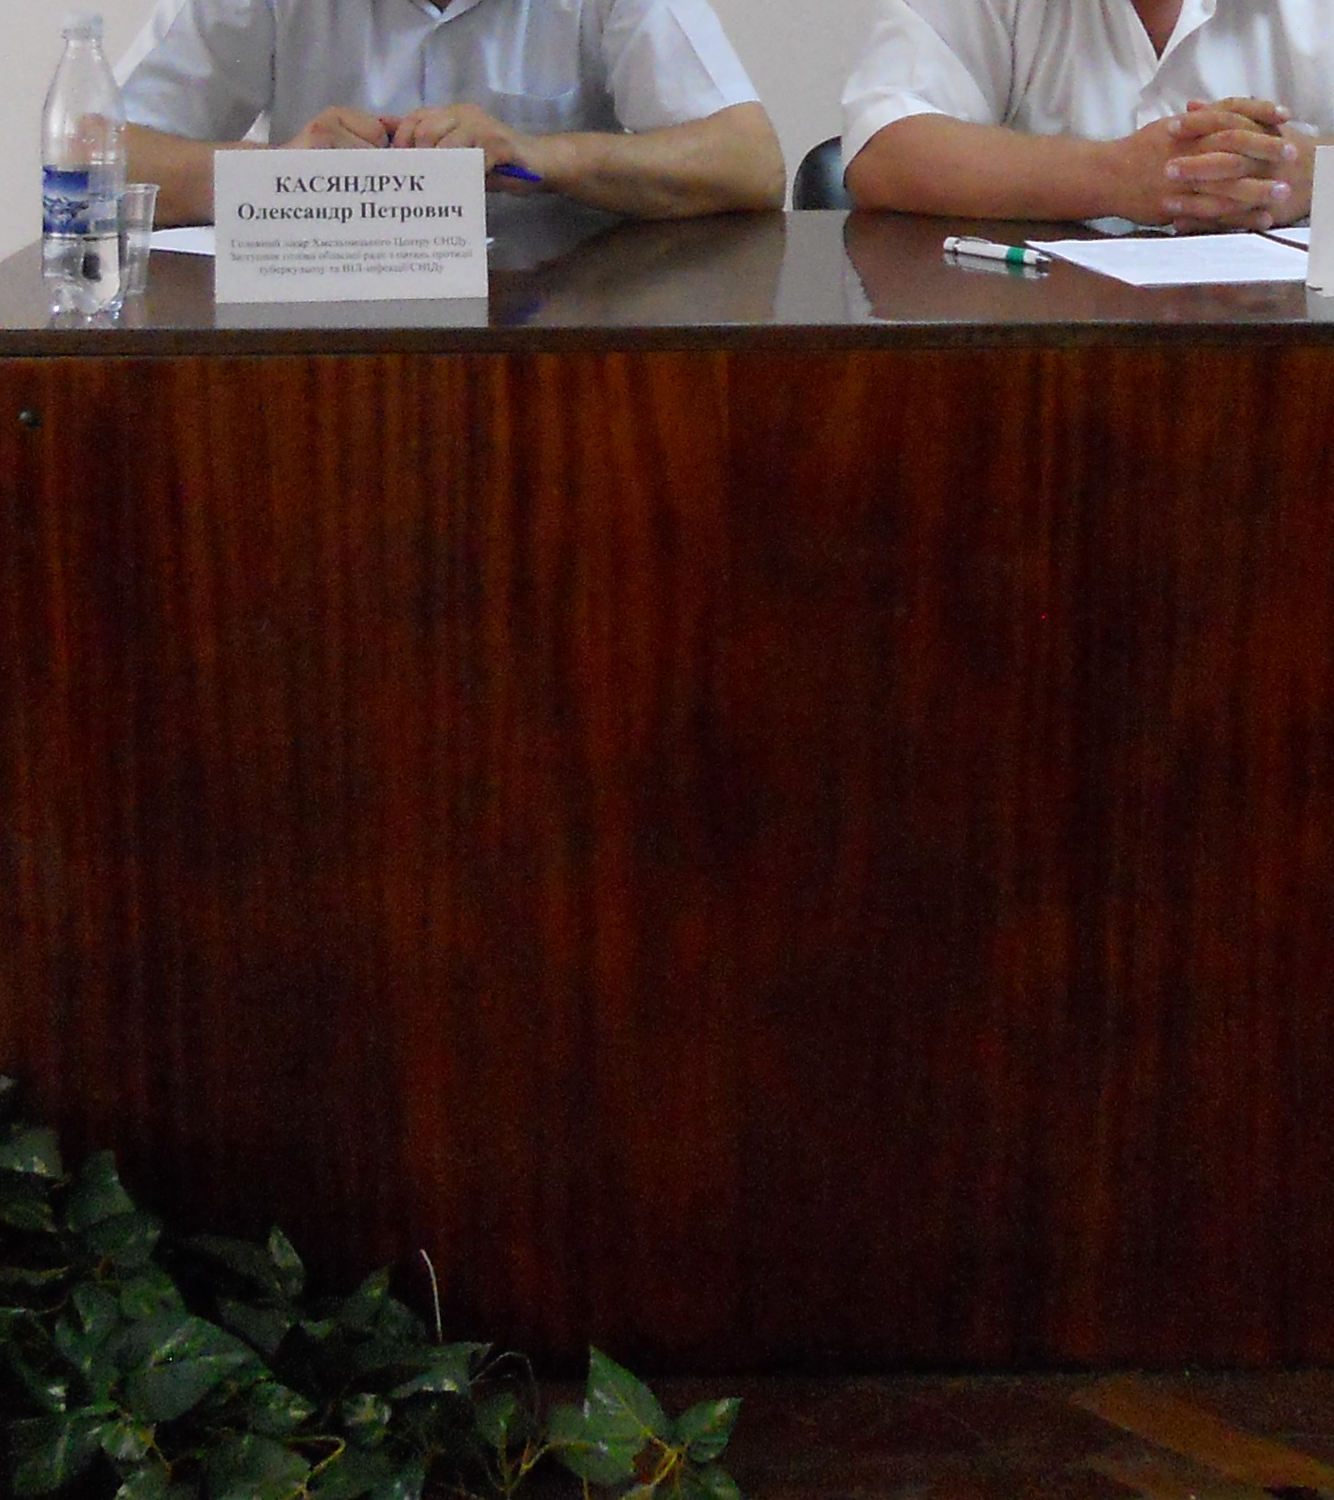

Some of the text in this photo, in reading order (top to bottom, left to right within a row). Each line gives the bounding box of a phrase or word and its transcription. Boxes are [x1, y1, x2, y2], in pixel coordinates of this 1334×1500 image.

[275, 174, 425, 194] КАСЯНДРУК
[237, 202, 463, 223] Олександр Петрович
